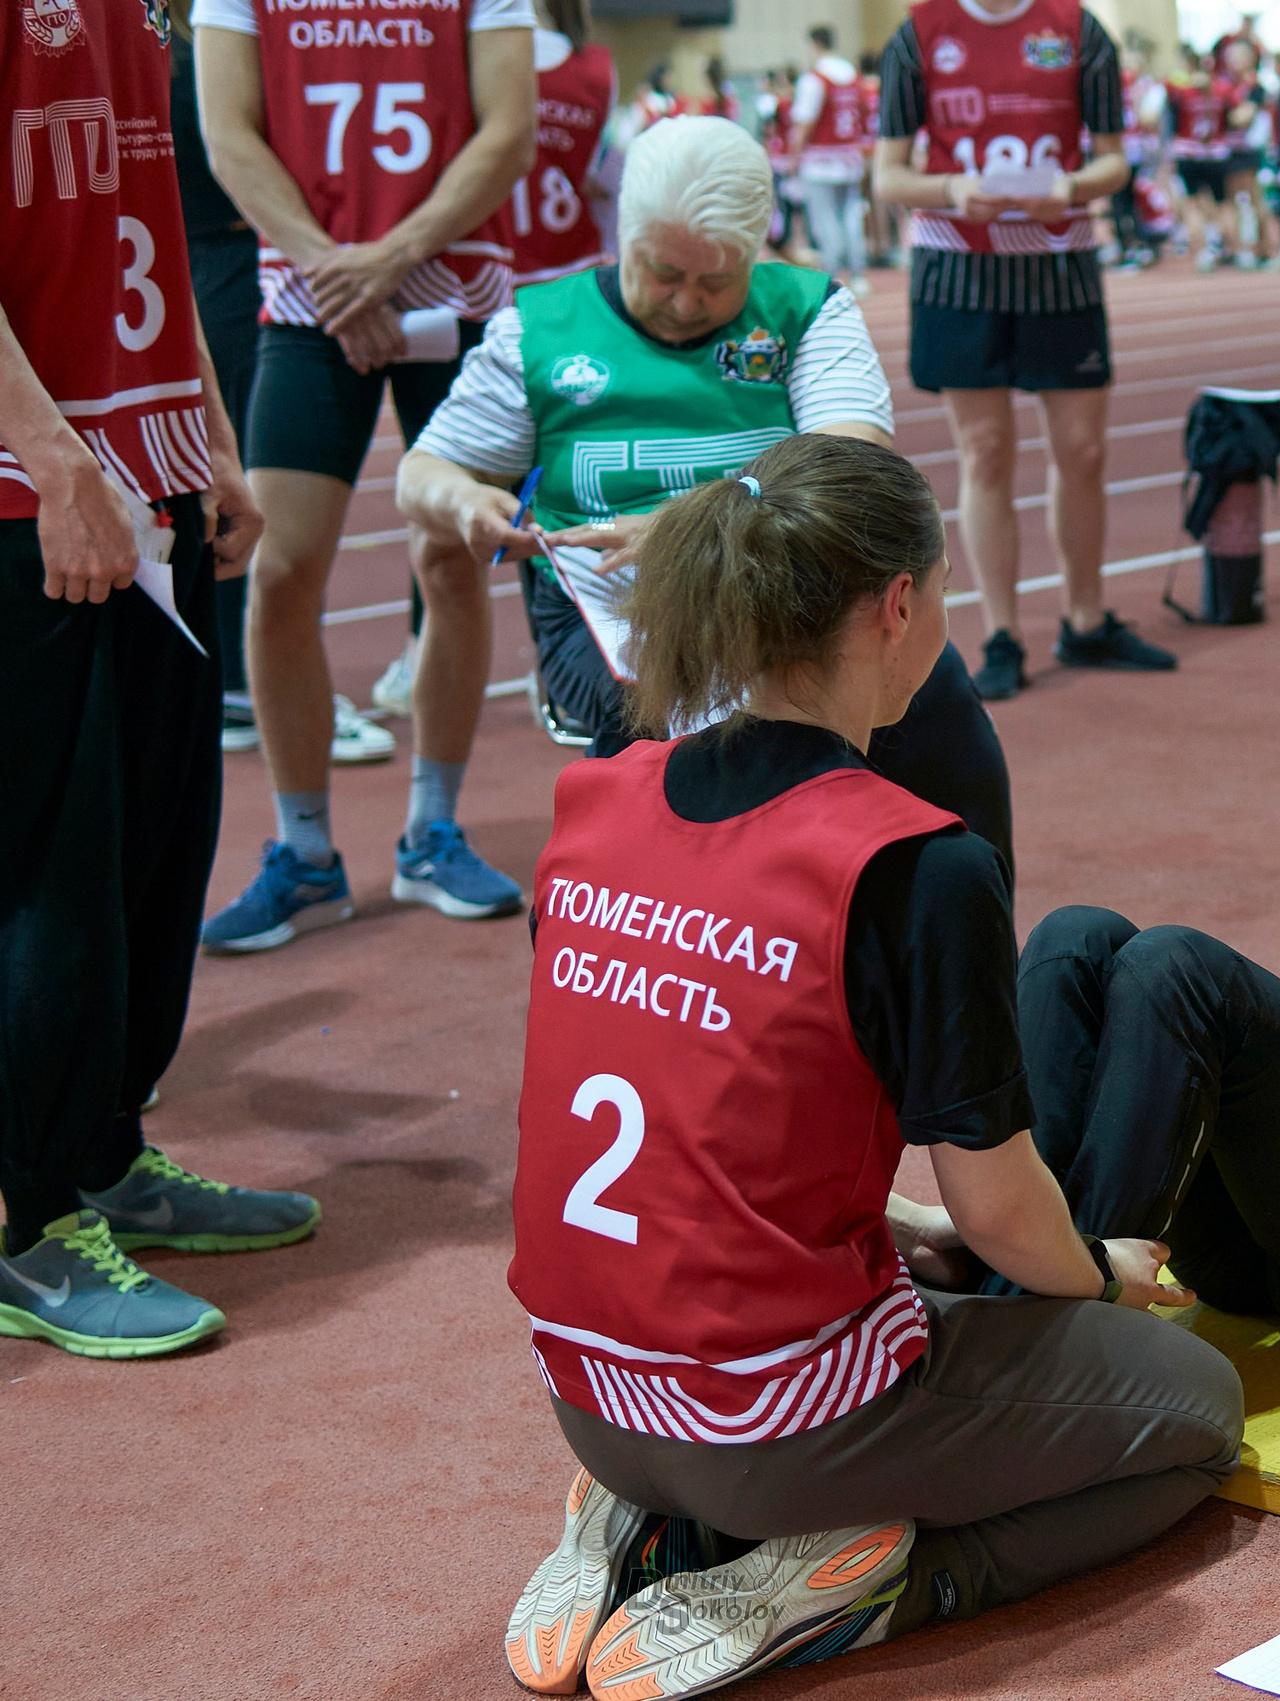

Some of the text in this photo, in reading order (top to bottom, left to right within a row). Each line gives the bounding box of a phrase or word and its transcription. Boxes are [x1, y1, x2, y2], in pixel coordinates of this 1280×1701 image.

[47, 12, 67, 26] ГТО
[289, 18, 435, 49] ОБЛАСТЬ
[12, 97, 120, 208] ГТО
[305, 82, 432, 175] 75
[512, 167, 582, 236] 18
[115, 215, 166, 352] 3
[547, 877, 799, 983] ТЮМЕНСКАЯ
[552, 946, 732, 1032] ОБЛАСТЬ
[562, 1073, 646, 1246] 2
